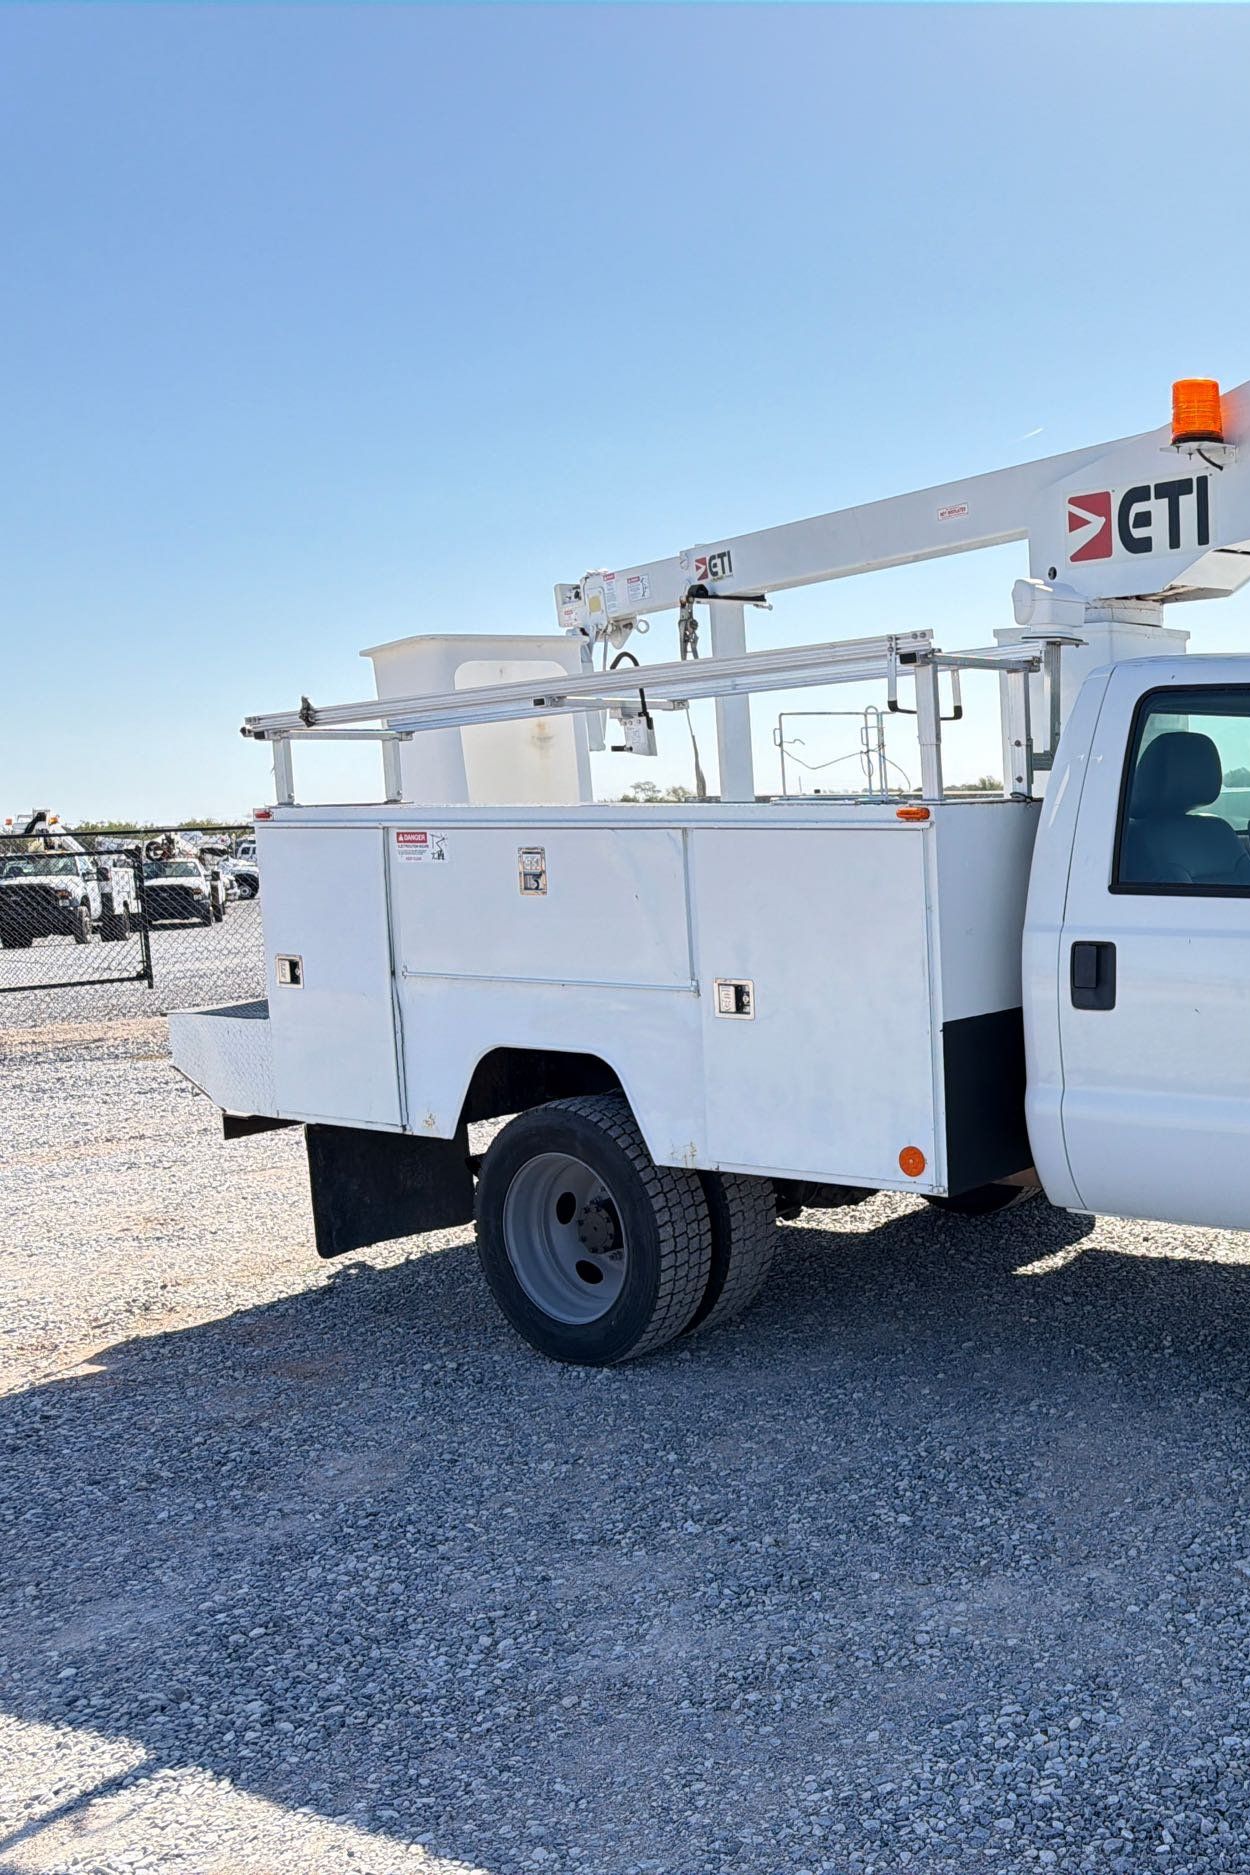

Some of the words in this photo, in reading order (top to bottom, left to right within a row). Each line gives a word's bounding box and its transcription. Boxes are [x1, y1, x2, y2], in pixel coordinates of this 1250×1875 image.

[1118, 475, 1209, 554] ETI
[708, 550, 732, 577] ETI
[403, 833, 426, 841] DANGER
